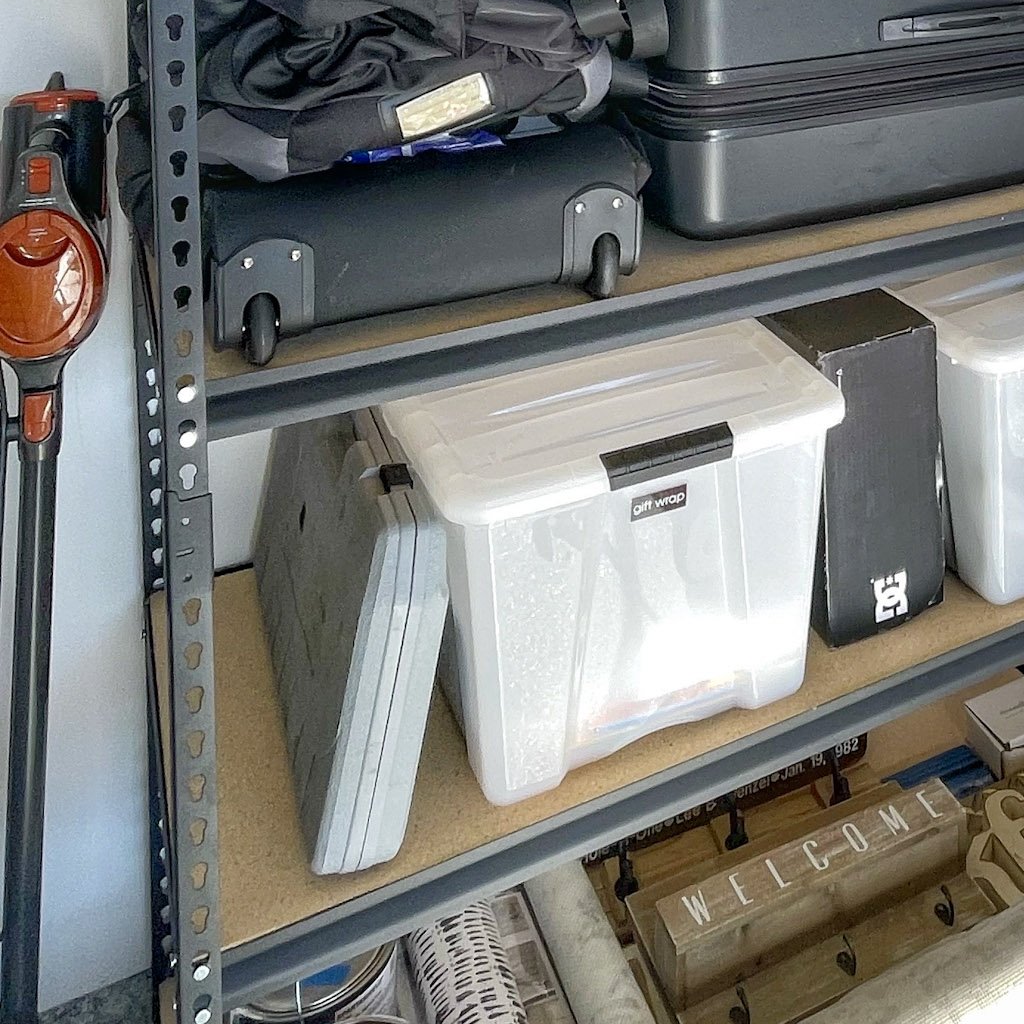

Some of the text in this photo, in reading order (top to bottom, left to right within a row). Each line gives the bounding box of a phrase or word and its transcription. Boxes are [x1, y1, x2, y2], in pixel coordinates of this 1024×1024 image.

[633, 491, 686, 516] gift wrap
[834, 737, 859, 758] 982
[681, 789, 944, 926] WELCOME
